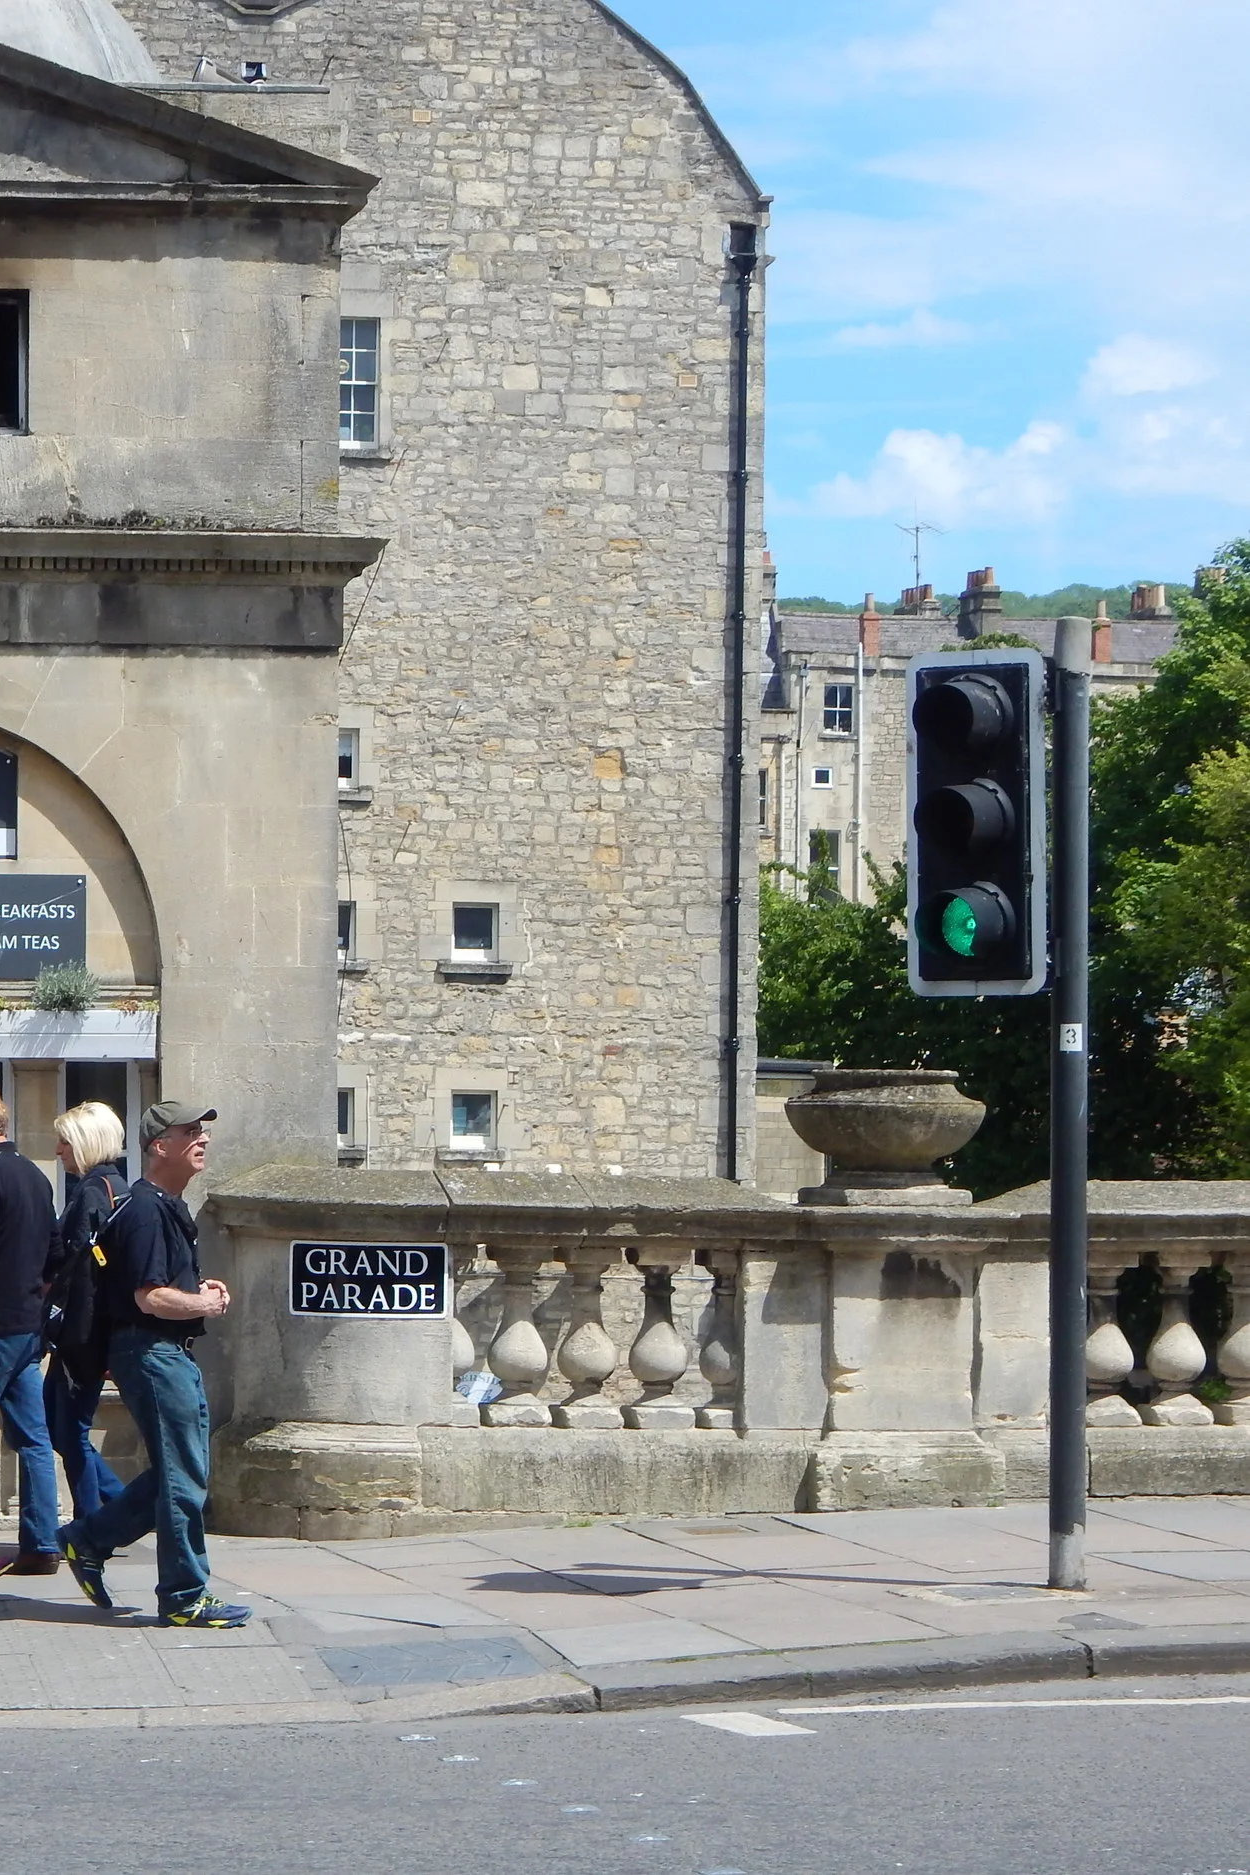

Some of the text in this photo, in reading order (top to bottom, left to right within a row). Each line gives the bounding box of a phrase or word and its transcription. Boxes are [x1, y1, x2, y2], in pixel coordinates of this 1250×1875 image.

[22, 935, 60, 950] TEAS
[1066, 1028, 1077, 1044] 3
[305, 1249, 429, 1276] GRAND
[300, 1282, 436, 1311] PARADE
